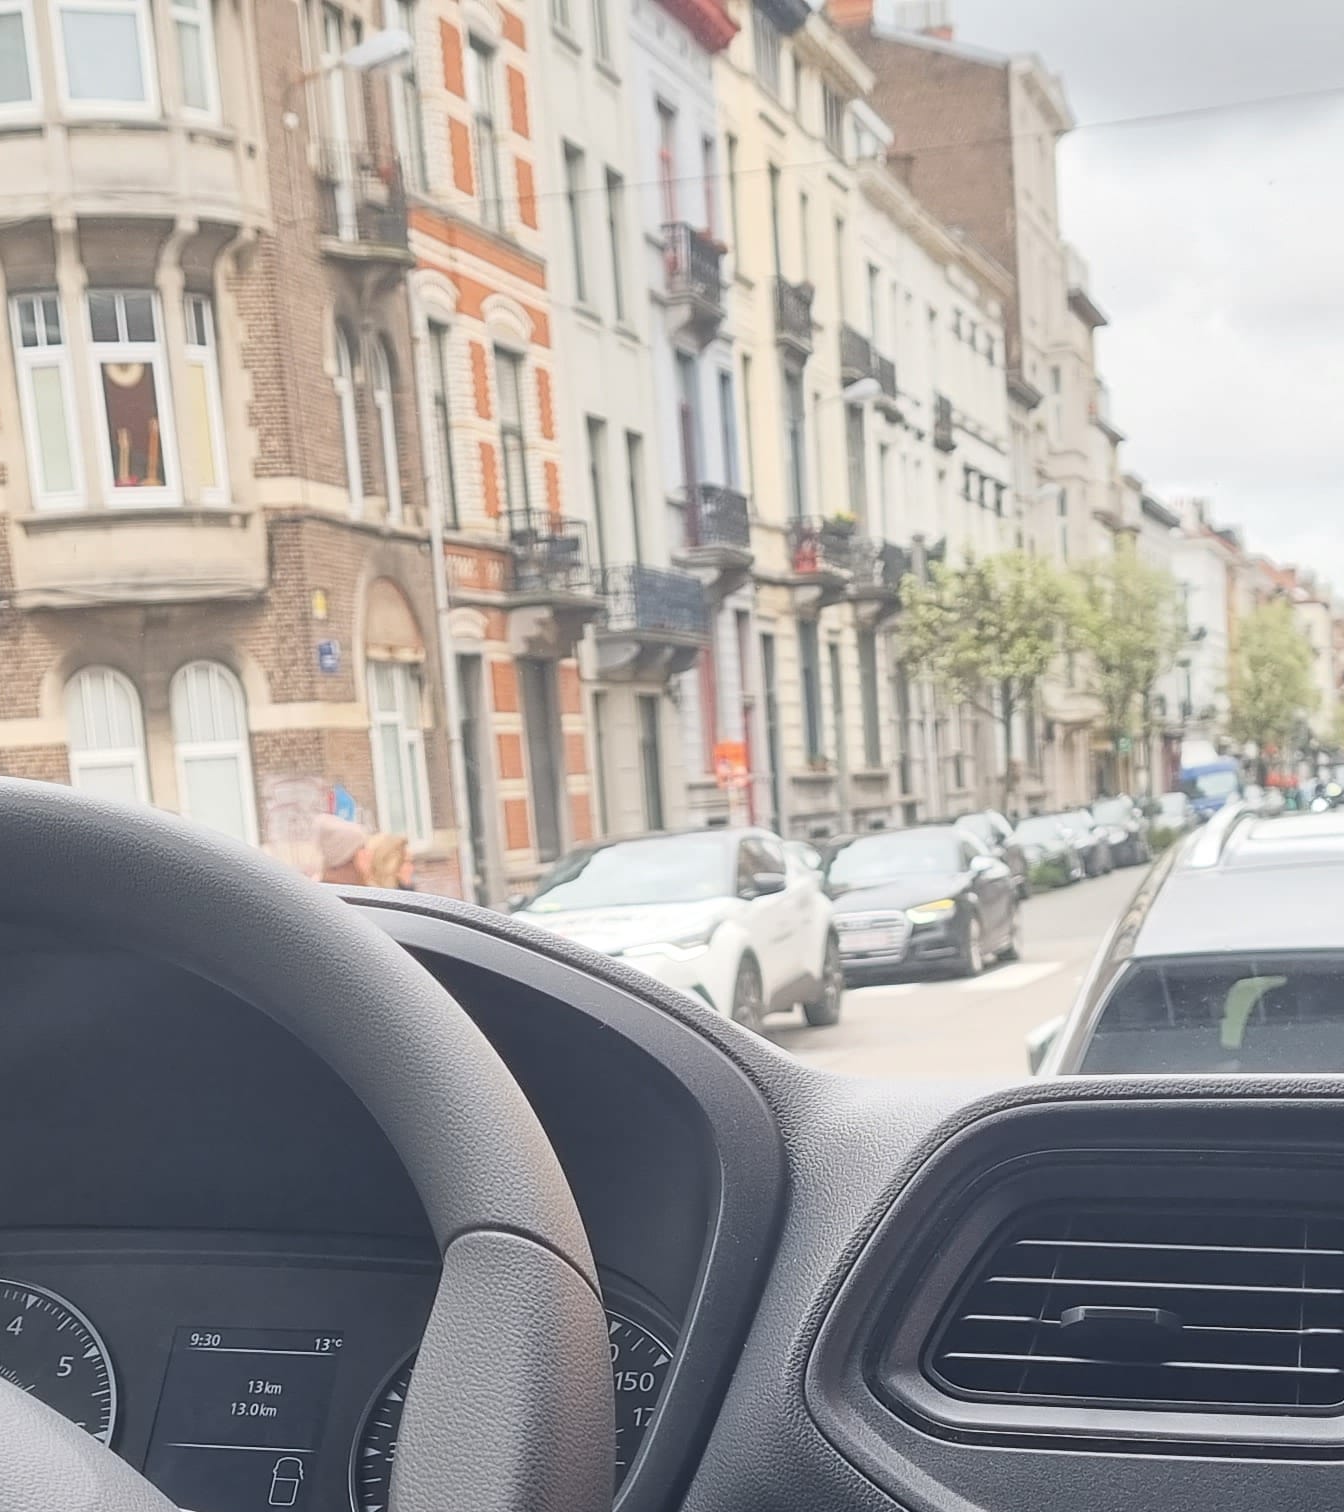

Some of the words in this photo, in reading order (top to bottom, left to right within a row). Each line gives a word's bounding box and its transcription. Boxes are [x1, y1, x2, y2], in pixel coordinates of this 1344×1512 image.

[6, 1315, 24, 1335] 4
[189, 1333, 221, 1346] 9:30
[314, 1338, 343, 1351] 13°C
[56, 1355, 74, 1377] 5
[615, 1371, 655, 1392] 150
[633, 1406, 656, 1428] 17
